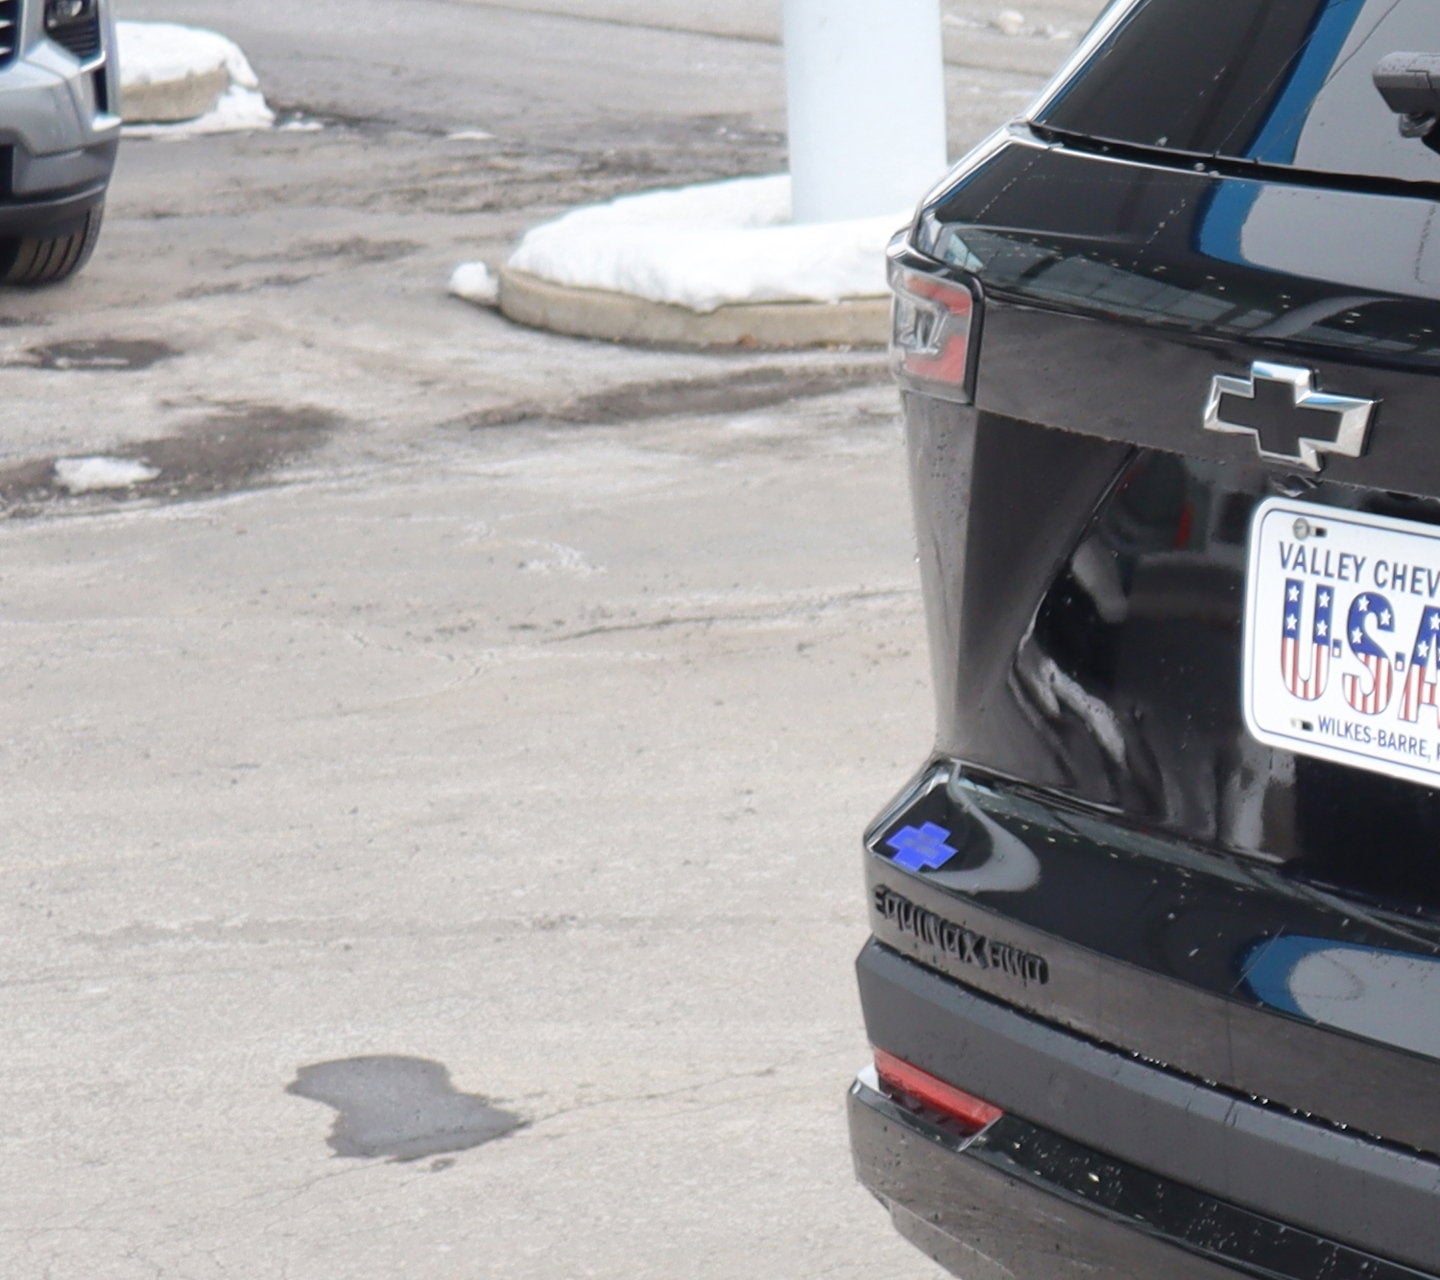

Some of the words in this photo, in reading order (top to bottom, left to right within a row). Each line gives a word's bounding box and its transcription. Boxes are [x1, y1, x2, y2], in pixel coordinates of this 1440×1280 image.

[1279, 541, 1367, 583] VALLEY
[1317, 714, 1432, 761] WILKES-BARRE,
[873, 883, 990, 970] EQUINOX
[990, 940, 1050, 986] AWD
